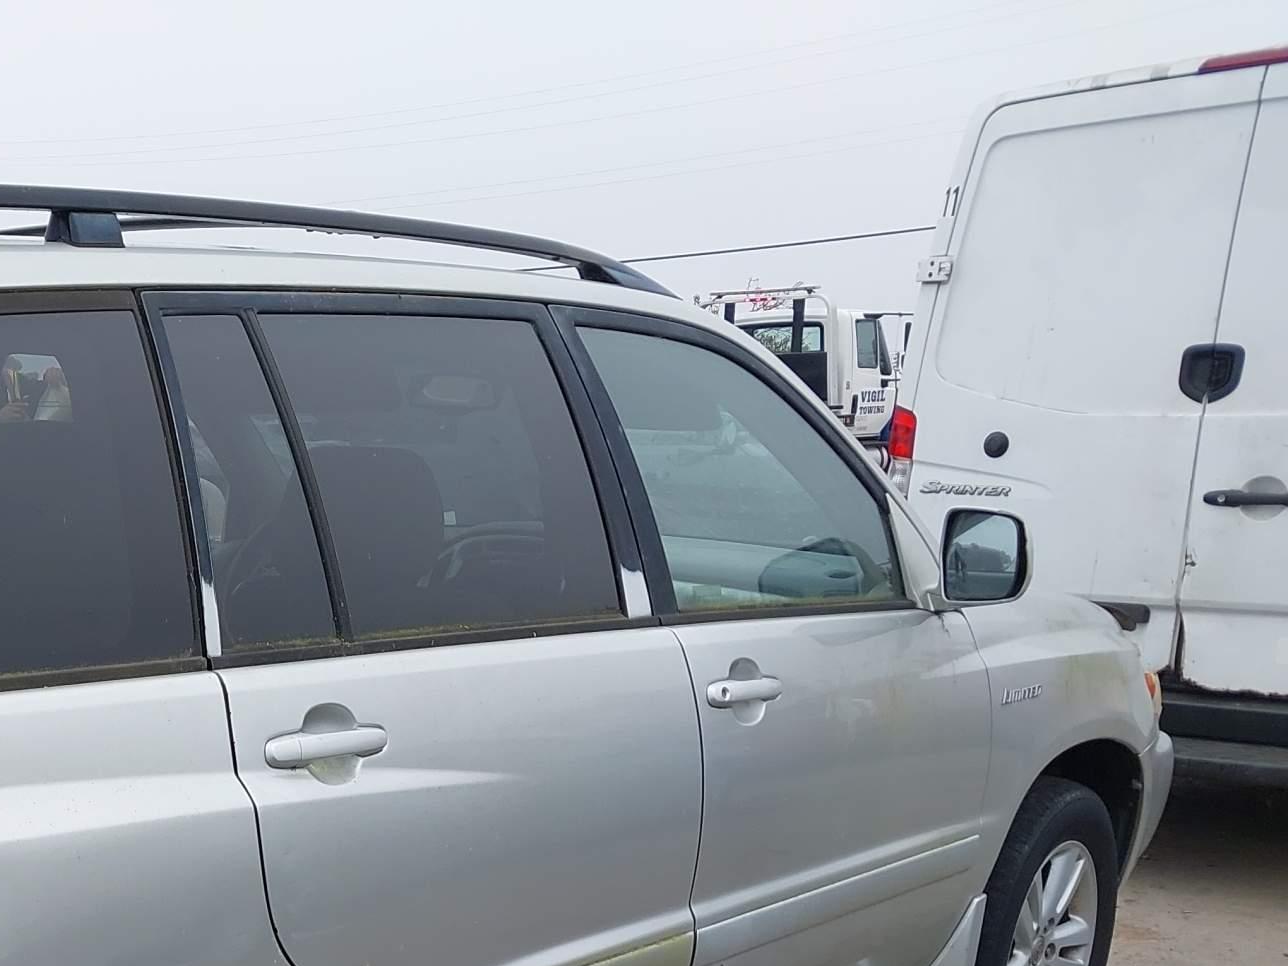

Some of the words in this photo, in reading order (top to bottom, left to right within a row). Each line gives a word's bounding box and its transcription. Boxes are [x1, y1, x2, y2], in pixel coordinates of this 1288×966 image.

[942, 185, 960, 217] 11
[861, 390, 886, 403] VIGIL
[859, 405, 885, 415] TOWING
[919, 481, 1012, 497] SPRINTER
